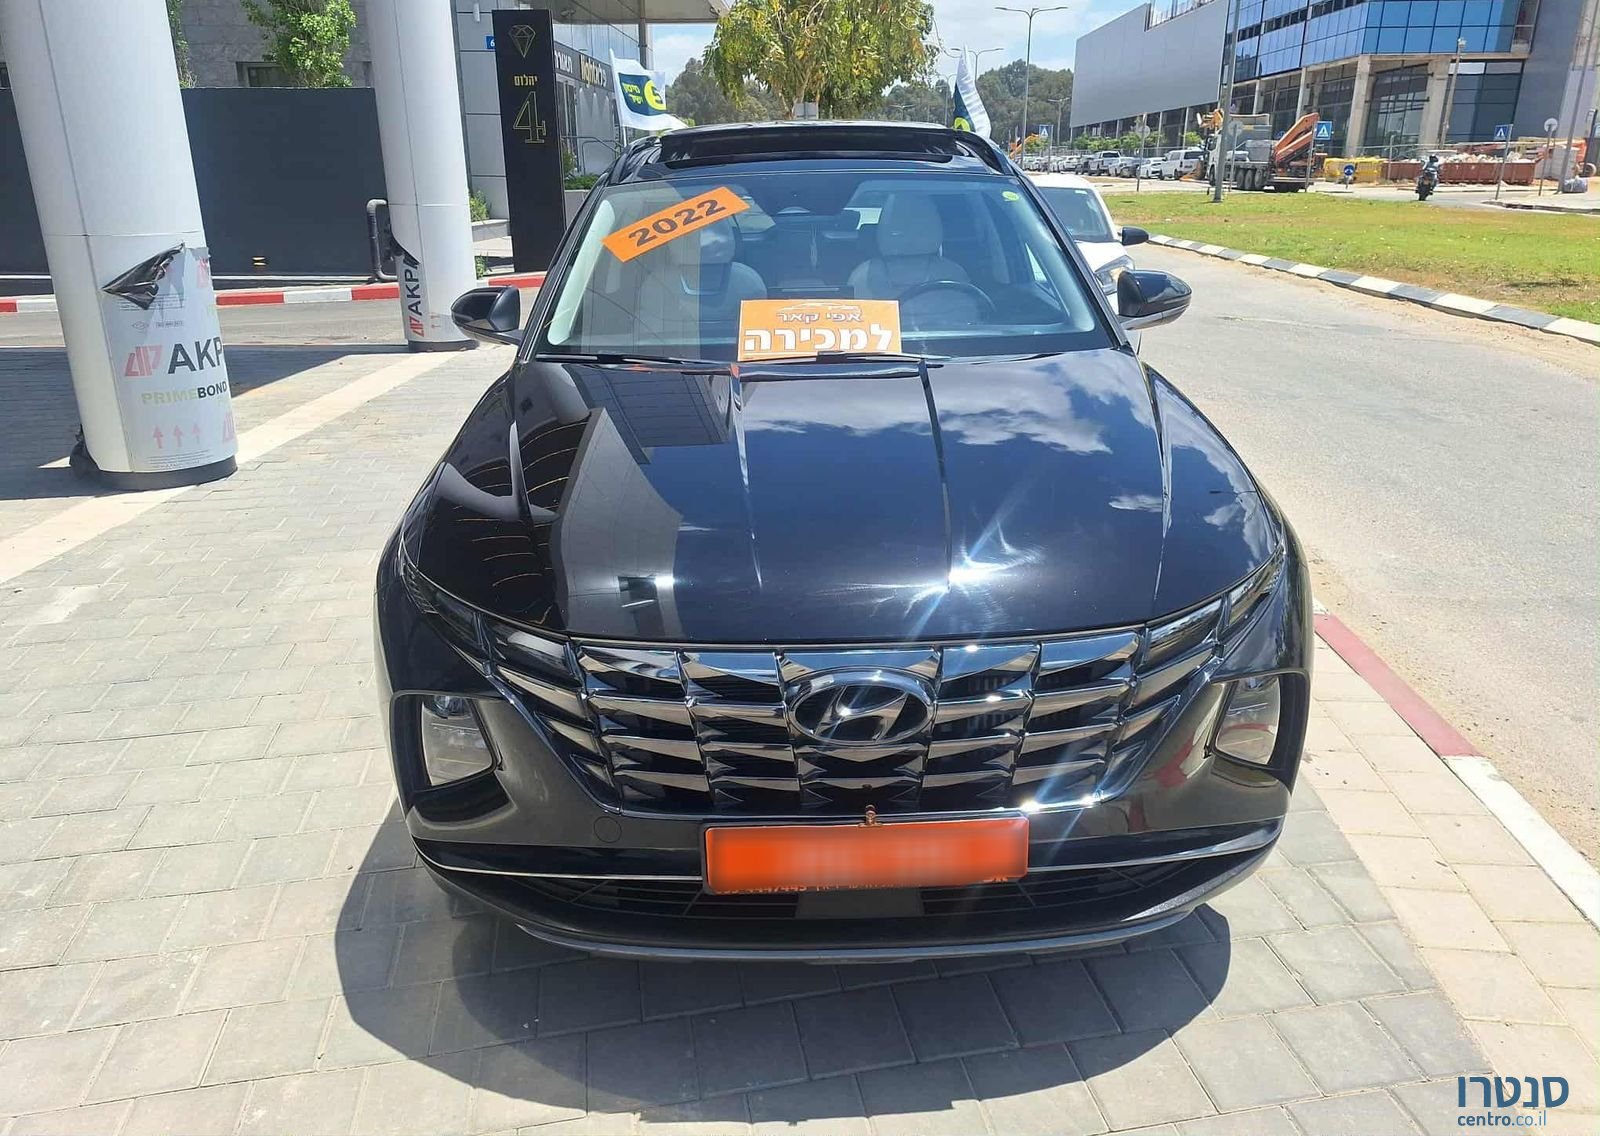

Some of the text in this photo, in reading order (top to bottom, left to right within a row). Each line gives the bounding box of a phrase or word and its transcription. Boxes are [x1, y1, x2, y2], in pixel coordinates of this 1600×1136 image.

[514, 74, 538, 86] יהלום
[513, 91, 547, 144] 4
[628, 199, 727, 247] 2022
[777, 312, 820, 324] קאר
[744, 323, 893, 351] למכירה
